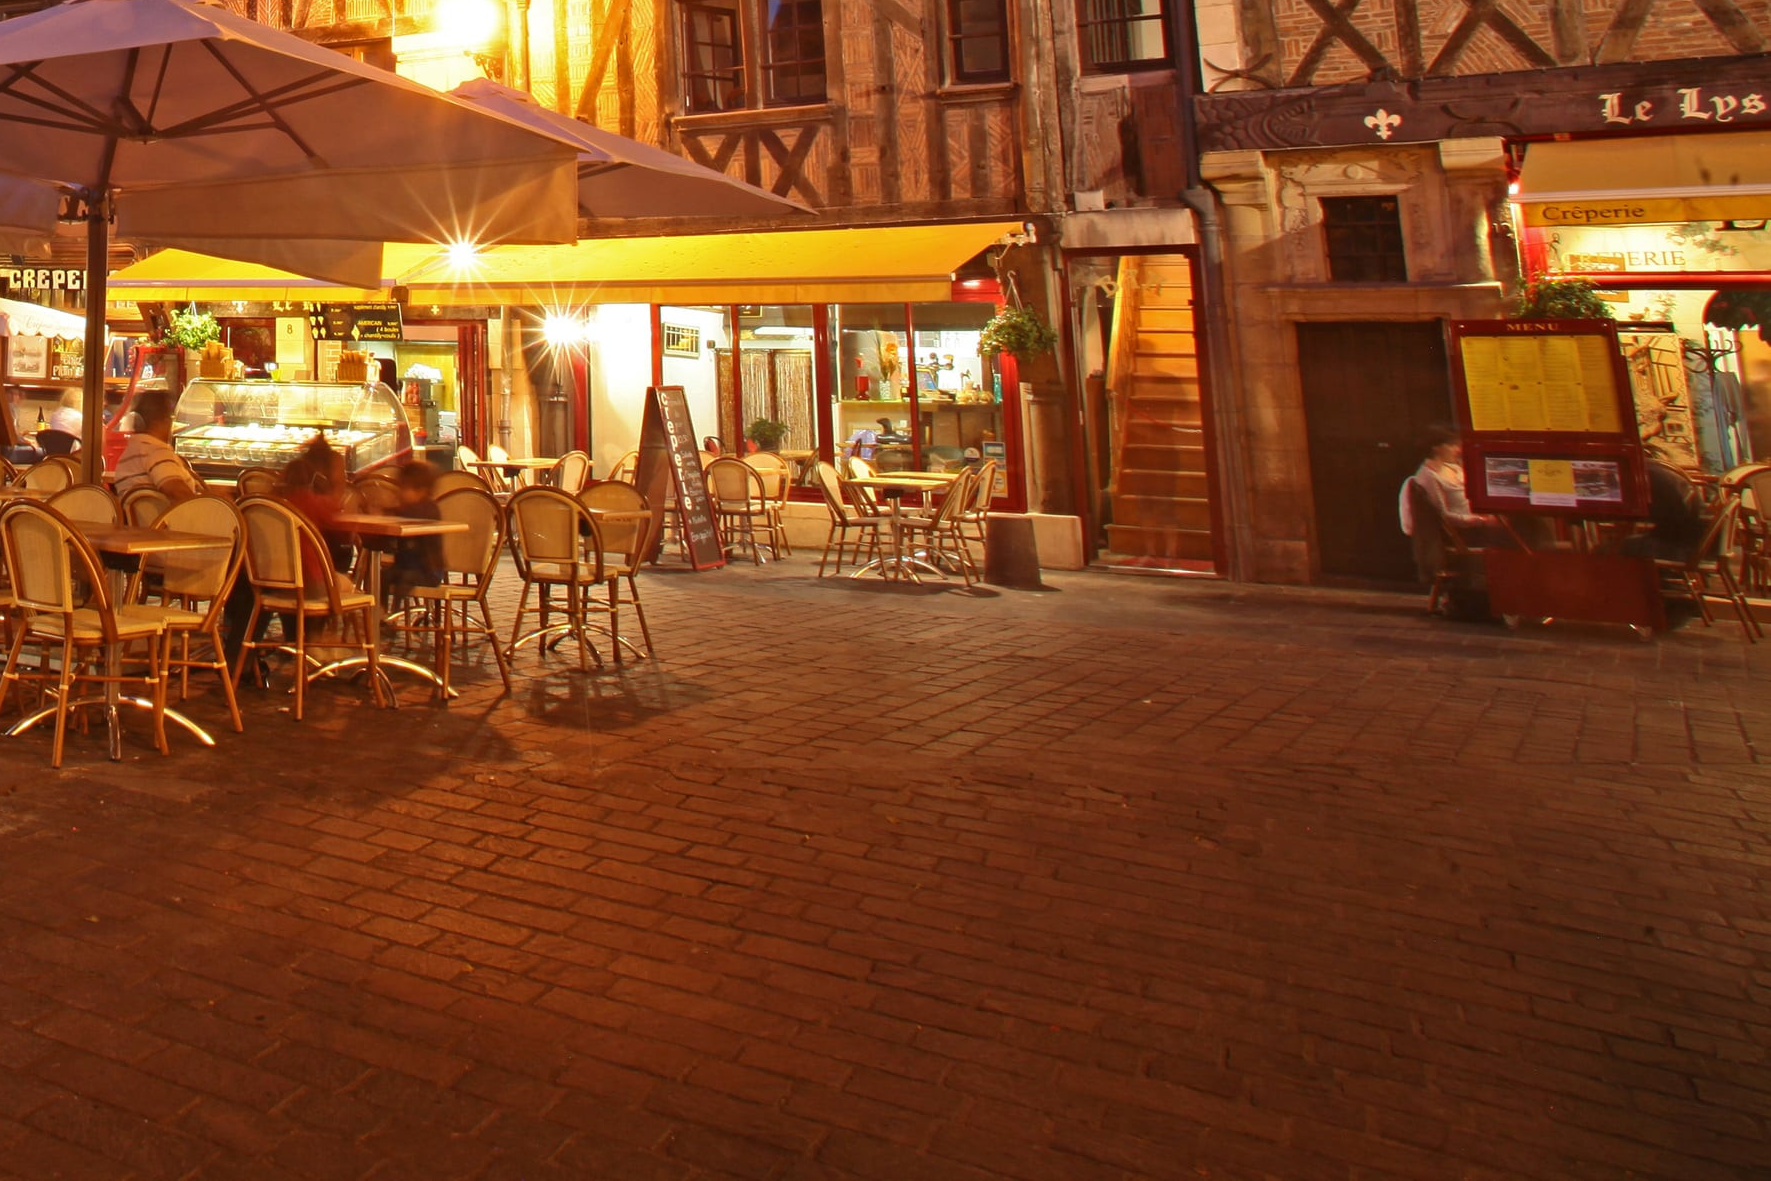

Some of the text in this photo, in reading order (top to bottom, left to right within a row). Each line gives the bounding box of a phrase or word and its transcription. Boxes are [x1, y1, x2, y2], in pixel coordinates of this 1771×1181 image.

[1599, 87, 1767, 124] Le Lys
[1542, 204, 1645, 222] Crêperie
[9, 269, 87, 290] CREPE
[286, 323, 293, 335] 8
[1506, 323, 1561, 331] MENU
